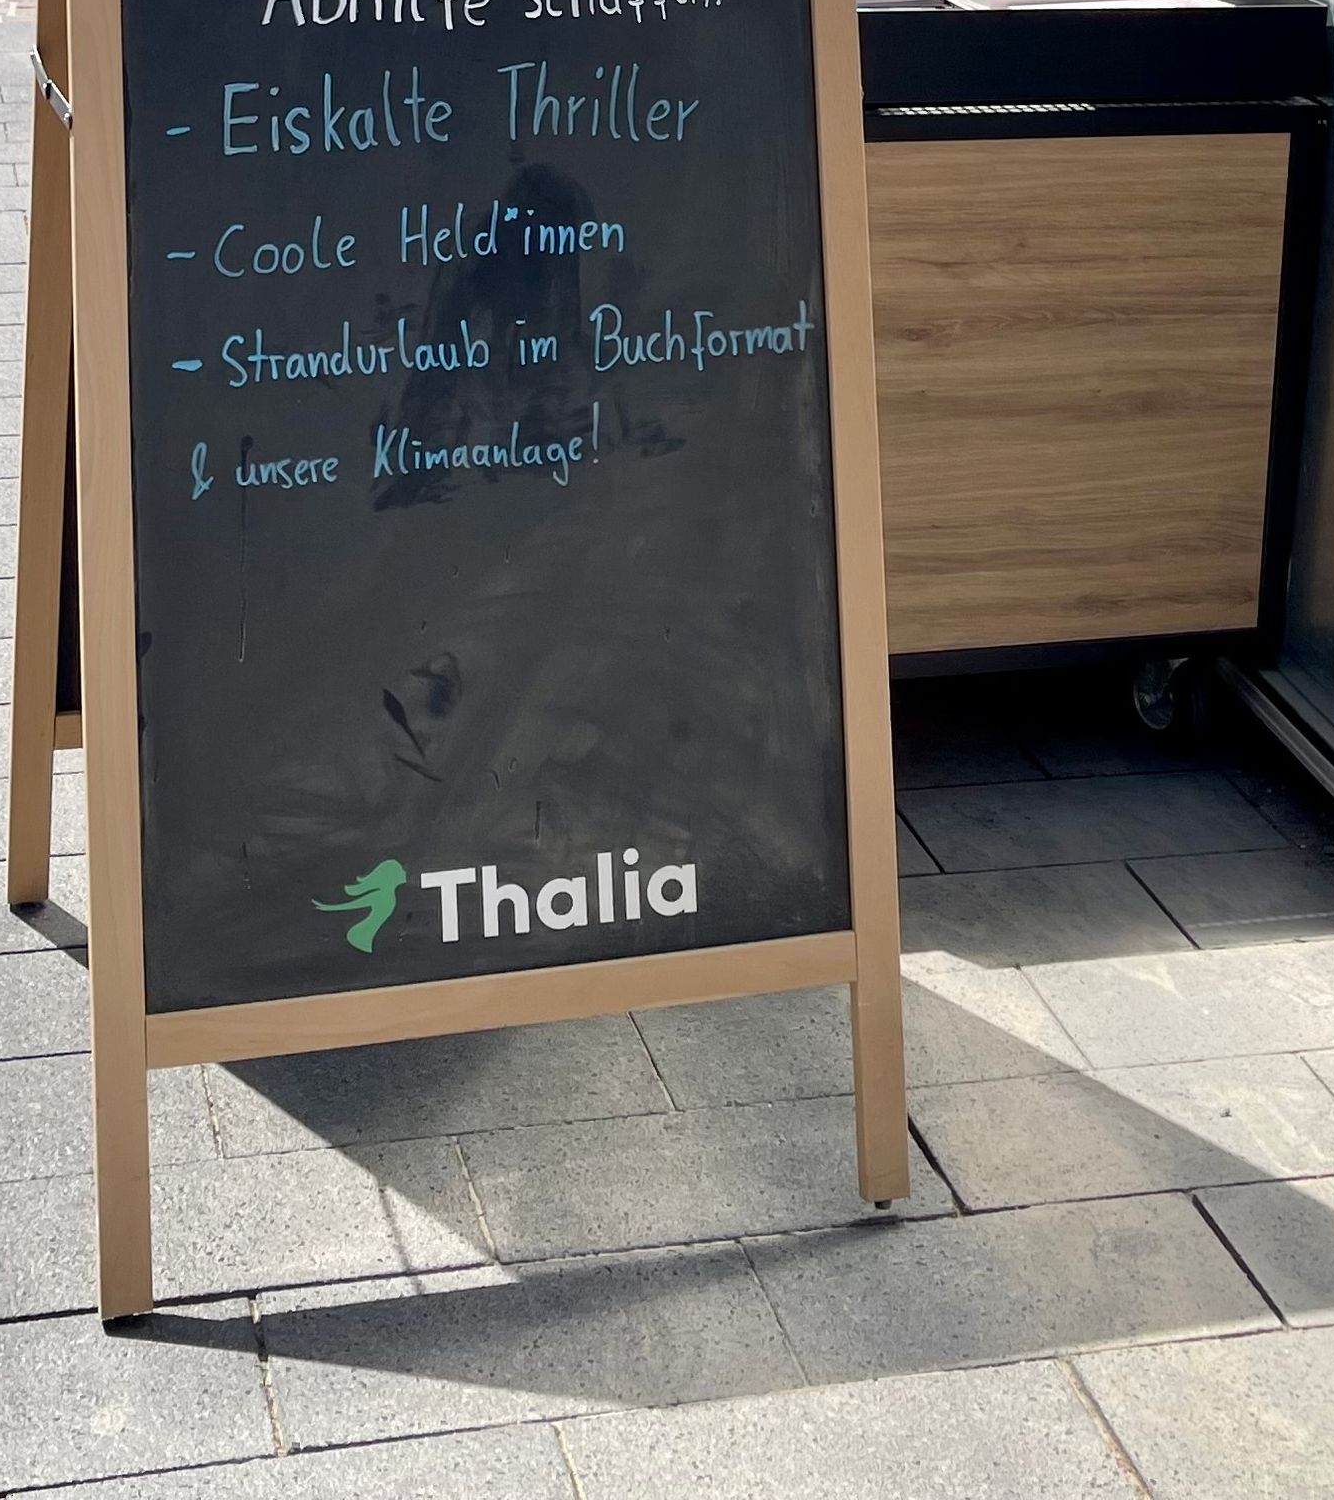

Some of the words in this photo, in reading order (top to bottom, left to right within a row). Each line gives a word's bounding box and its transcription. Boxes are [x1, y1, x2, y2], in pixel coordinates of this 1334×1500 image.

[223, 66, 453, 156] Eiskalte
[497, 60, 700, 142] Thriller
[214, 215, 357, 278] Coole
[221, 317, 491, 388] Strandurlaub
[515, 319, 558, 366] im
[589, 299, 815, 372] Buchformat
[235, 456, 339, 489] unsere
[373, 401, 600, 487] Klimaanlage!
[420, 847, 698, 943] Thalia
